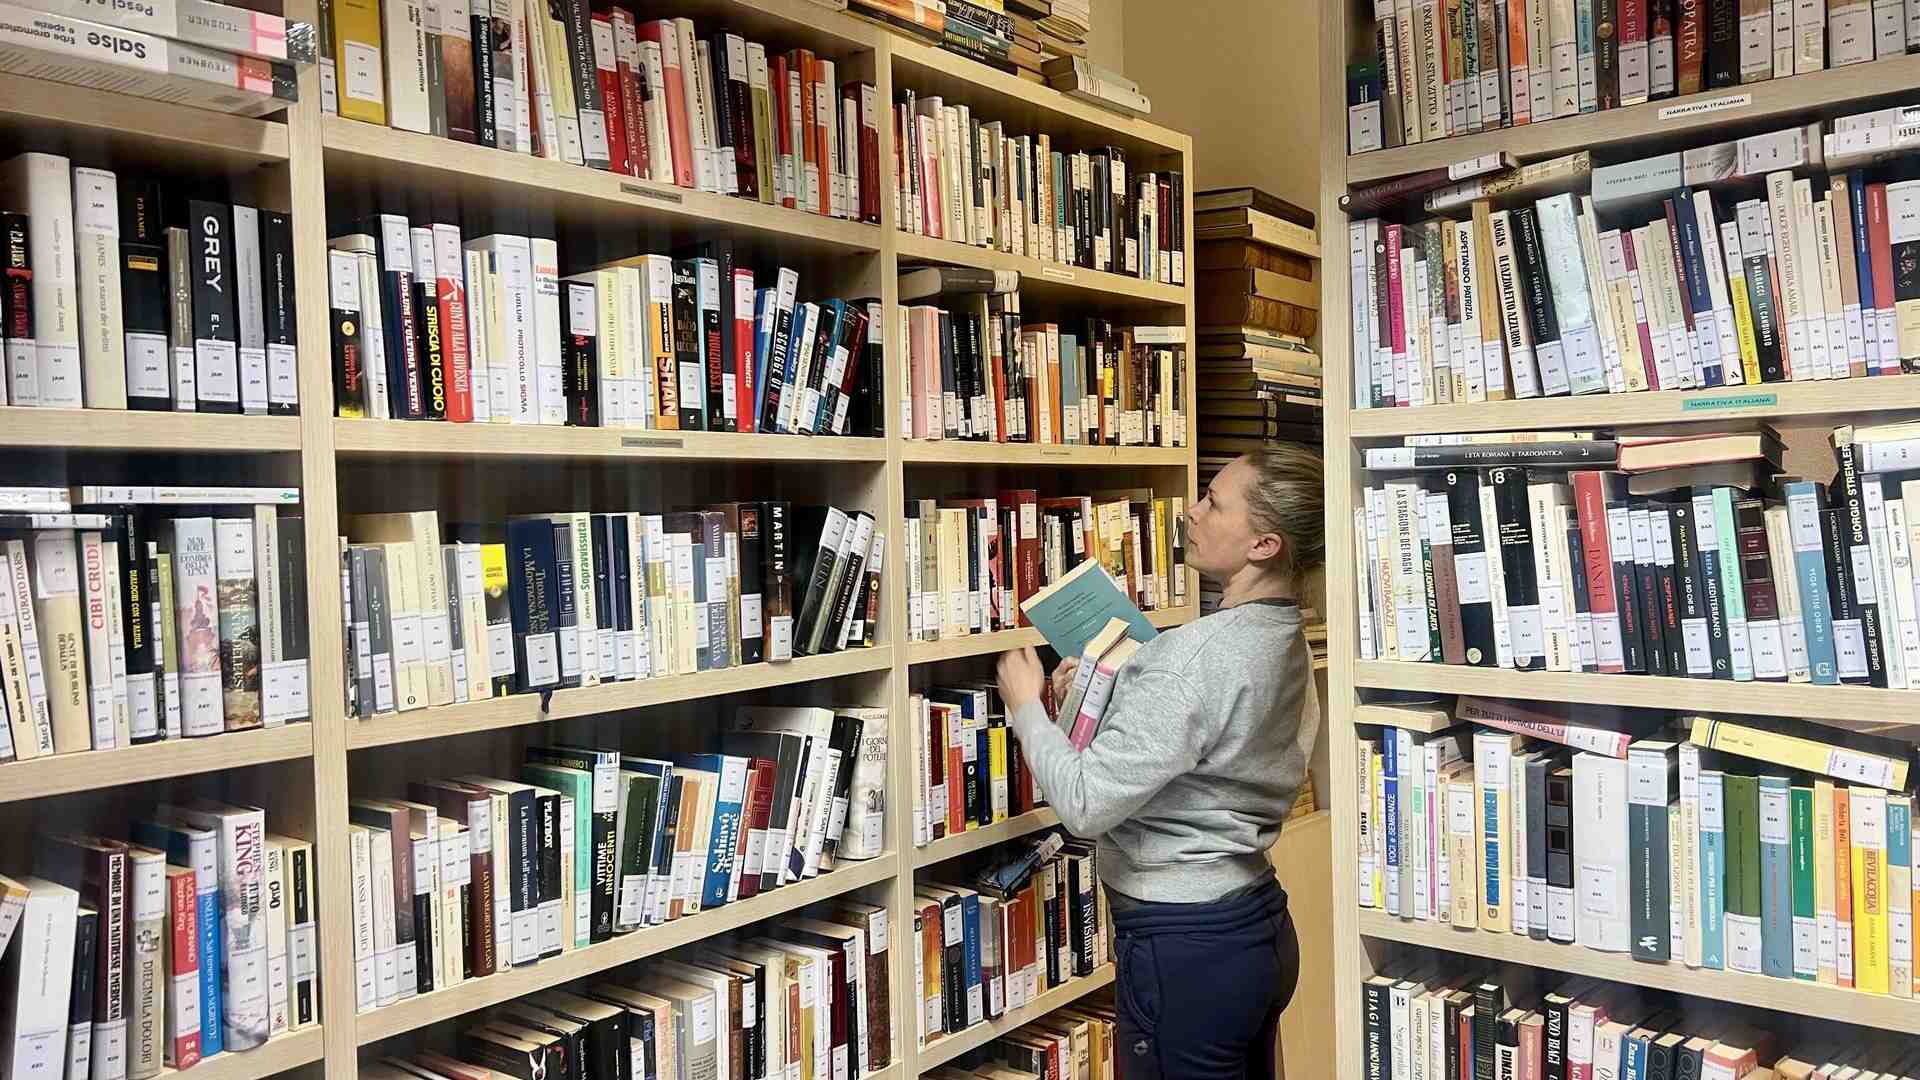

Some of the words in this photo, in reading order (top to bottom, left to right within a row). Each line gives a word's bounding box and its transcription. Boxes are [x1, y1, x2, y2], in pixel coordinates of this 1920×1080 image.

[87, 31, 146, 59] Salse
[576, 35, 586, 60] VOLTA
[581, 62, 589, 78] CHE
[1426, 86, 1438, 115] ZITTO
[1710, 97, 1746, 110] ITALIANA
[203, 216, 222, 293] GREY
[1459, 230, 1471, 284] ASPETTANDO
[400, 271, 411, 316] LUDLUM
[1462, 285, 1474, 321] PATRIZIA
[425, 305, 438, 352] STRISCIA
[448, 302, 465, 330] CONTO
[1508, 311, 1522, 348] AZZURRO
[427, 353, 439, 366] DI
[450, 331, 465, 352] ALLA
[772, 332, 787, 374] SCHEGGE
[431, 368, 445, 411] CUOIO
[453, 353, 468, 393] ROVESCIA
[659, 358, 677, 416] SHAN
[519, 383, 528, 413] SIGMA
[1447, 472, 1457, 485] 9
[1494, 471, 1506, 484] 8
[1841, 444, 1857, 496] STREHLER
[1395, 489, 1407, 499] LA
[1396, 500, 1409, 536] STAGIONE
[1849, 499, 1864, 543] GIORGIO
[773, 506, 784, 570] MARTIN
[86, 544, 100, 592] CRUDI
[1400, 552, 1413, 575] RAGNI
[1588, 548, 1606, 600] DANTE
[15, 580, 30, 618] CURATO
[524, 560, 536, 614] MONTAGNA
[534, 569, 547, 608] THOMAS
[1424, 559, 1432, 572] GLI
[1429, 607, 1439, 631] CARTA
[90, 600, 104, 630] CIBI
[131, 602, 140, 617] CON
[1707, 578, 1722, 638] MEDITERRANEO
[520, 806, 529, 819] La
[543, 800, 553, 848] PLAYBOY
[235, 825, 253, 876] KING
[252, 822, 261, 873] STEPHEN
[596, 842, 607, 885] VITTIME
[606, 831, 616, 895] INNOCENTI
[1387, 847, 1396, 864] VOCI
[111, 856, 123, 894] MEMORIE
[269, 880, 282, 909] CUJO
[111, 896, 122, 906] DI
[111, 907, 122, 924] UNA
[249, 881, 261, 913] TUTTO
[110, 925, 121, 971] MAITRESSE
[1082, 903, 1094, 964] INVISIBILE
[110, 972, 121, 1019] AMERICANA
[142, 960, 156, 1019] DIECIMILA
[1368, 990, 1379, 1026] BIAGI
[1548, 1009, 1561, 1036] ENZO
[141, 1021, 153, 1064] DOLORI
[1547, 1038, 1561, 1064] BIAGI
